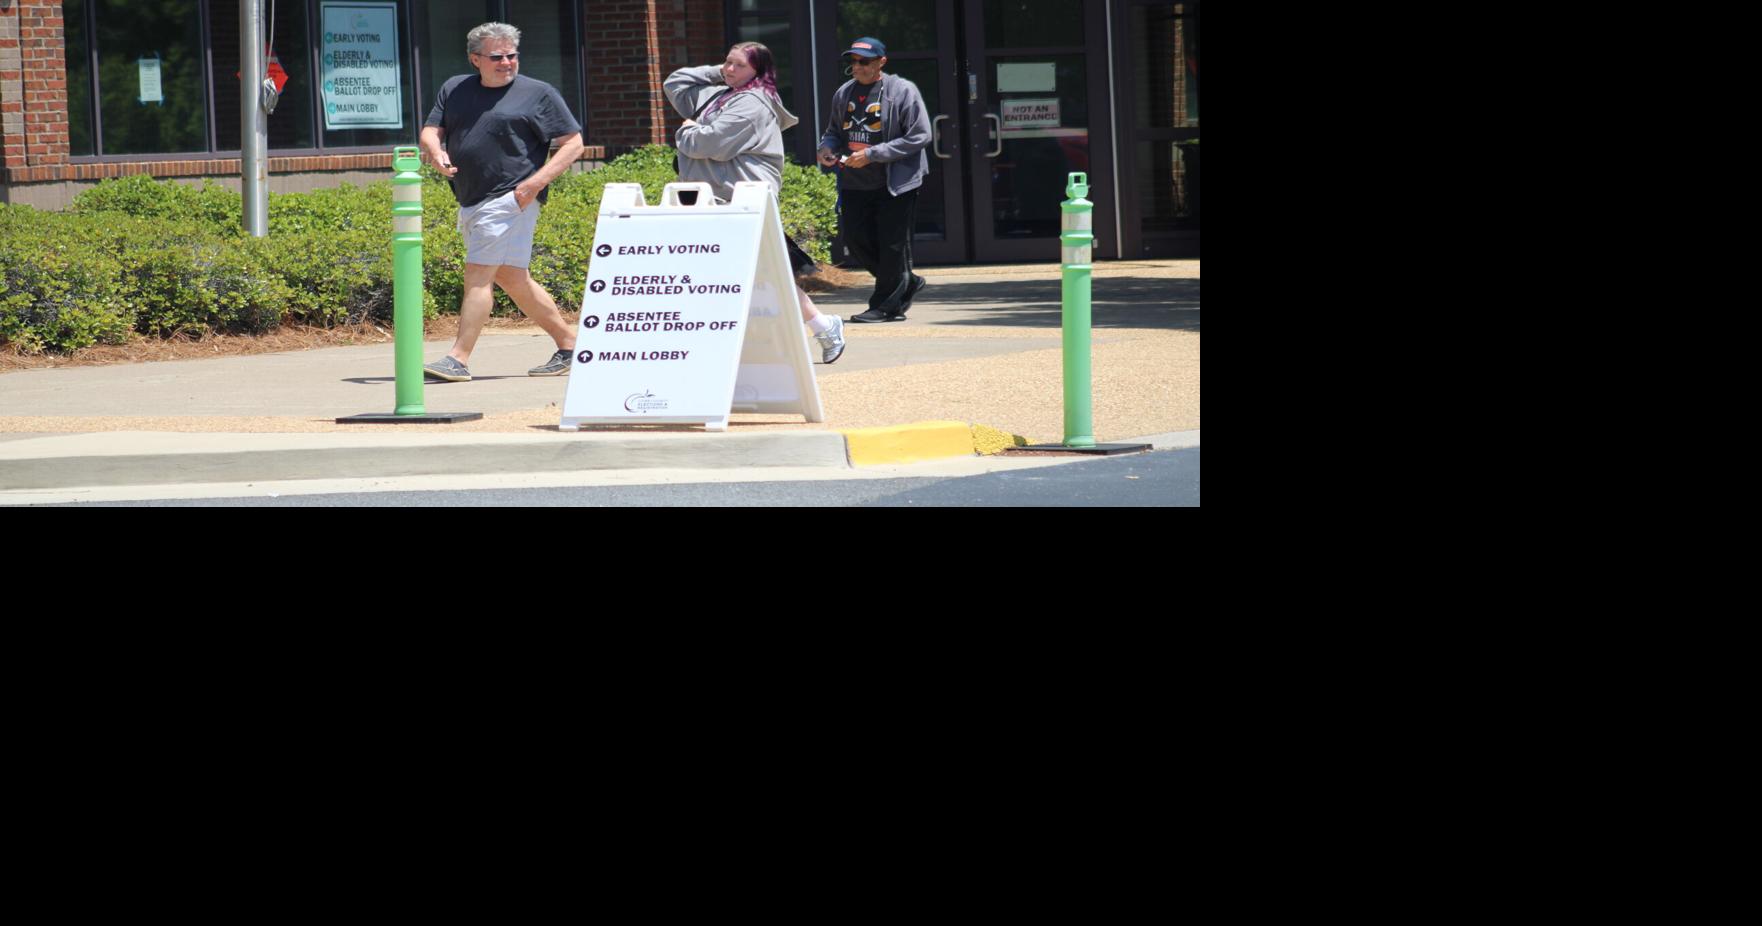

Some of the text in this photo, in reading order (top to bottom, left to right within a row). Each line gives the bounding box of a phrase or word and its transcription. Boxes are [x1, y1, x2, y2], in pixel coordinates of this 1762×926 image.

[333, 33, 381, 43] EARLY VOTING
[333, 50, 363, 59] ELDERLY
[333, 60, 394, 69] DISABLED VOTING
[334, 77, 371, 86] ABSENTEE
[334, 86, 396, 95] BALLOT DROP OFF
[336, 103, 379, 113] MAIN LOBBY
[1035, 105, 1049, 113] AN
[618, 244, 721, 255] EARLY VOTING
[613, 275, 692, 285] ELDERLY &
[611, 284, 742, 296] DISABLED VOTING
[606, 311, 681, 322] ABSENTEE
[605, 321, 738, 332] BALLOT DROP OFF
[598, 350, 690, 361] MAIN LOBBY
